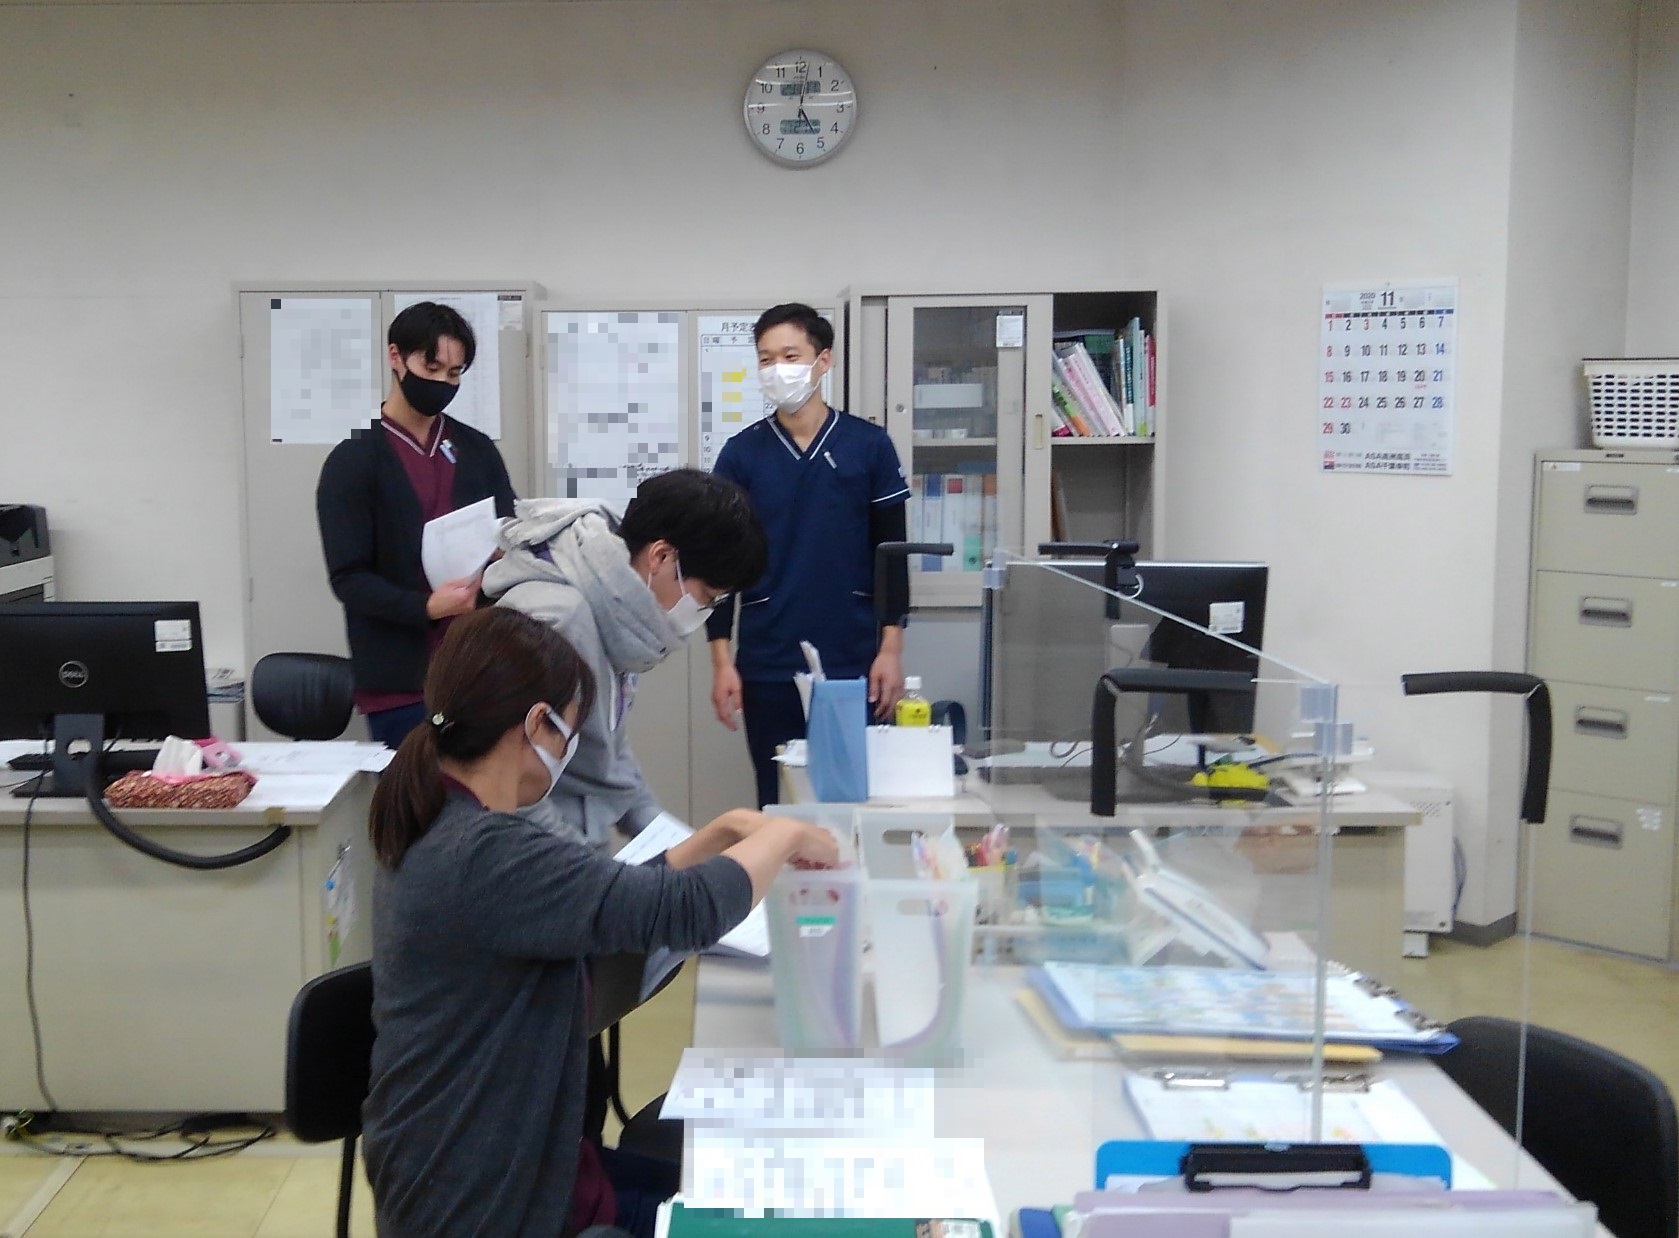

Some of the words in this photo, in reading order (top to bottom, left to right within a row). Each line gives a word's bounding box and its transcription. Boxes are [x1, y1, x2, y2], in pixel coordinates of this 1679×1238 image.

[776, 68, 786, 78] 11
[795, 61, 807, 74] 12
[818, 66, 822, 78] 1
[761, 83, 772, 94] 10
[831, 80, 839, 92] 2
[757, 103, 765, 114] 9
[836, 102, 844, 113] 3
[762, 124, 770, 135] 8
[830, 122, 838, 134] 4
[777, 138, 784, 149] 7
[796, 143, 804, 154] 6
[817, 137, 824, 149] 5
[1359, 292, 1376, 300] 2020
[1380, 291, 1396, 306] 11
[1328, 320, 1333, 331] 1
[1345, 319, 1352, 331] 2
[1363, 319, 1369, 330] 3
[1381, 318, 1388, 330] 4
[1401, 317, 1406, 329] 5
[1419, 317, 1425, 329] 6
[1438, 316, 1444, 328] 7
[1327, 345, 1333, 357] 8
[1344, 345, 1351, 357] 9
[1361, 345, 1371, 357] 10
[1379, 344, 1388, 356] 11
[1398, 344, 1408, 356] 12
[1417, 343, 1426, 356] 13
[1435, 343, 1445, 355] 14
[1324, 371, 1334, 383] 15
[1342, 371, 1352, 383] 16
[1360, 371, 1369, 382] 17
[1378, 370, 1388, 382] 18
[1397, 370, 1407, 382] 19
[1414, 369, 1425, 382] 20
[1433, 369, 1443, 382] 21
[1323, 397, 1334, 409] 22
[1341, 397, 1351, 409] 23
[1358, 397, 1369, 409] 24
[1376, 397, 1387, 409] 25
[1395, 397, 1406, 409] 26
[1413, 397, 1424, 409] 27
[1432, 397, 1443, 409] 28
[1323, 422, 1334, 434] 29
[1340, 423, 1351, 434] 30
